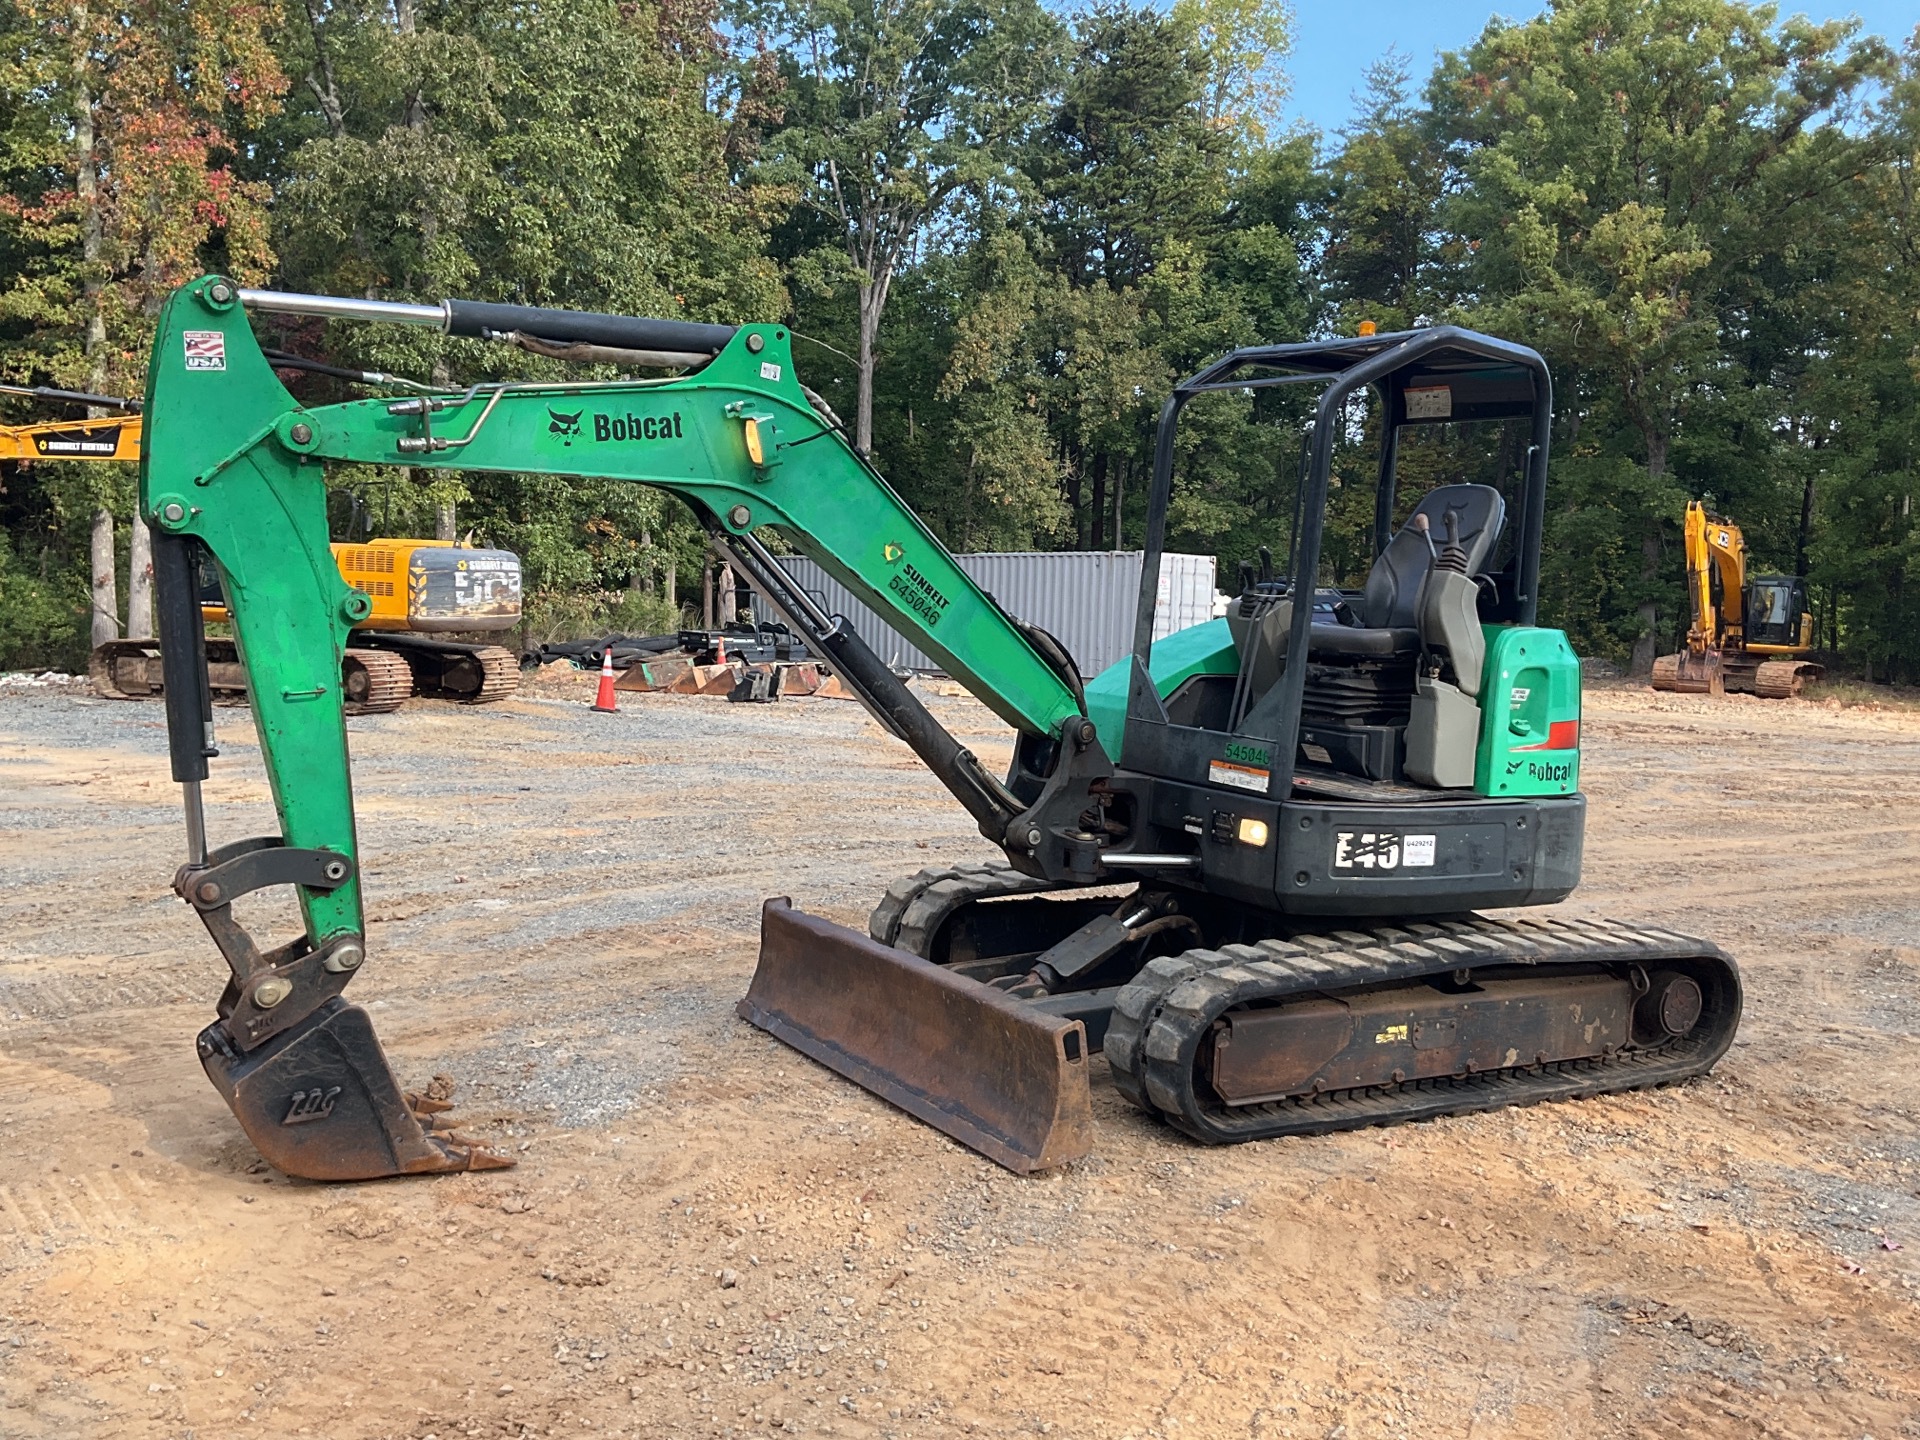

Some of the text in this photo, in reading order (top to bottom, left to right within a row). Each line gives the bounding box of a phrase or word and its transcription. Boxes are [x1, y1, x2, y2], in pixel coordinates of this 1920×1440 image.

[188, 357, 223, 367] USA
[594, 412, 683, 442] Bobcat
[888, 573, 941, 627] 545046
[903, 563, 950, 610] SUNBELT
[1225, 743, 1271, 765] 545046
[1335, 832, 1400, 870] E45
